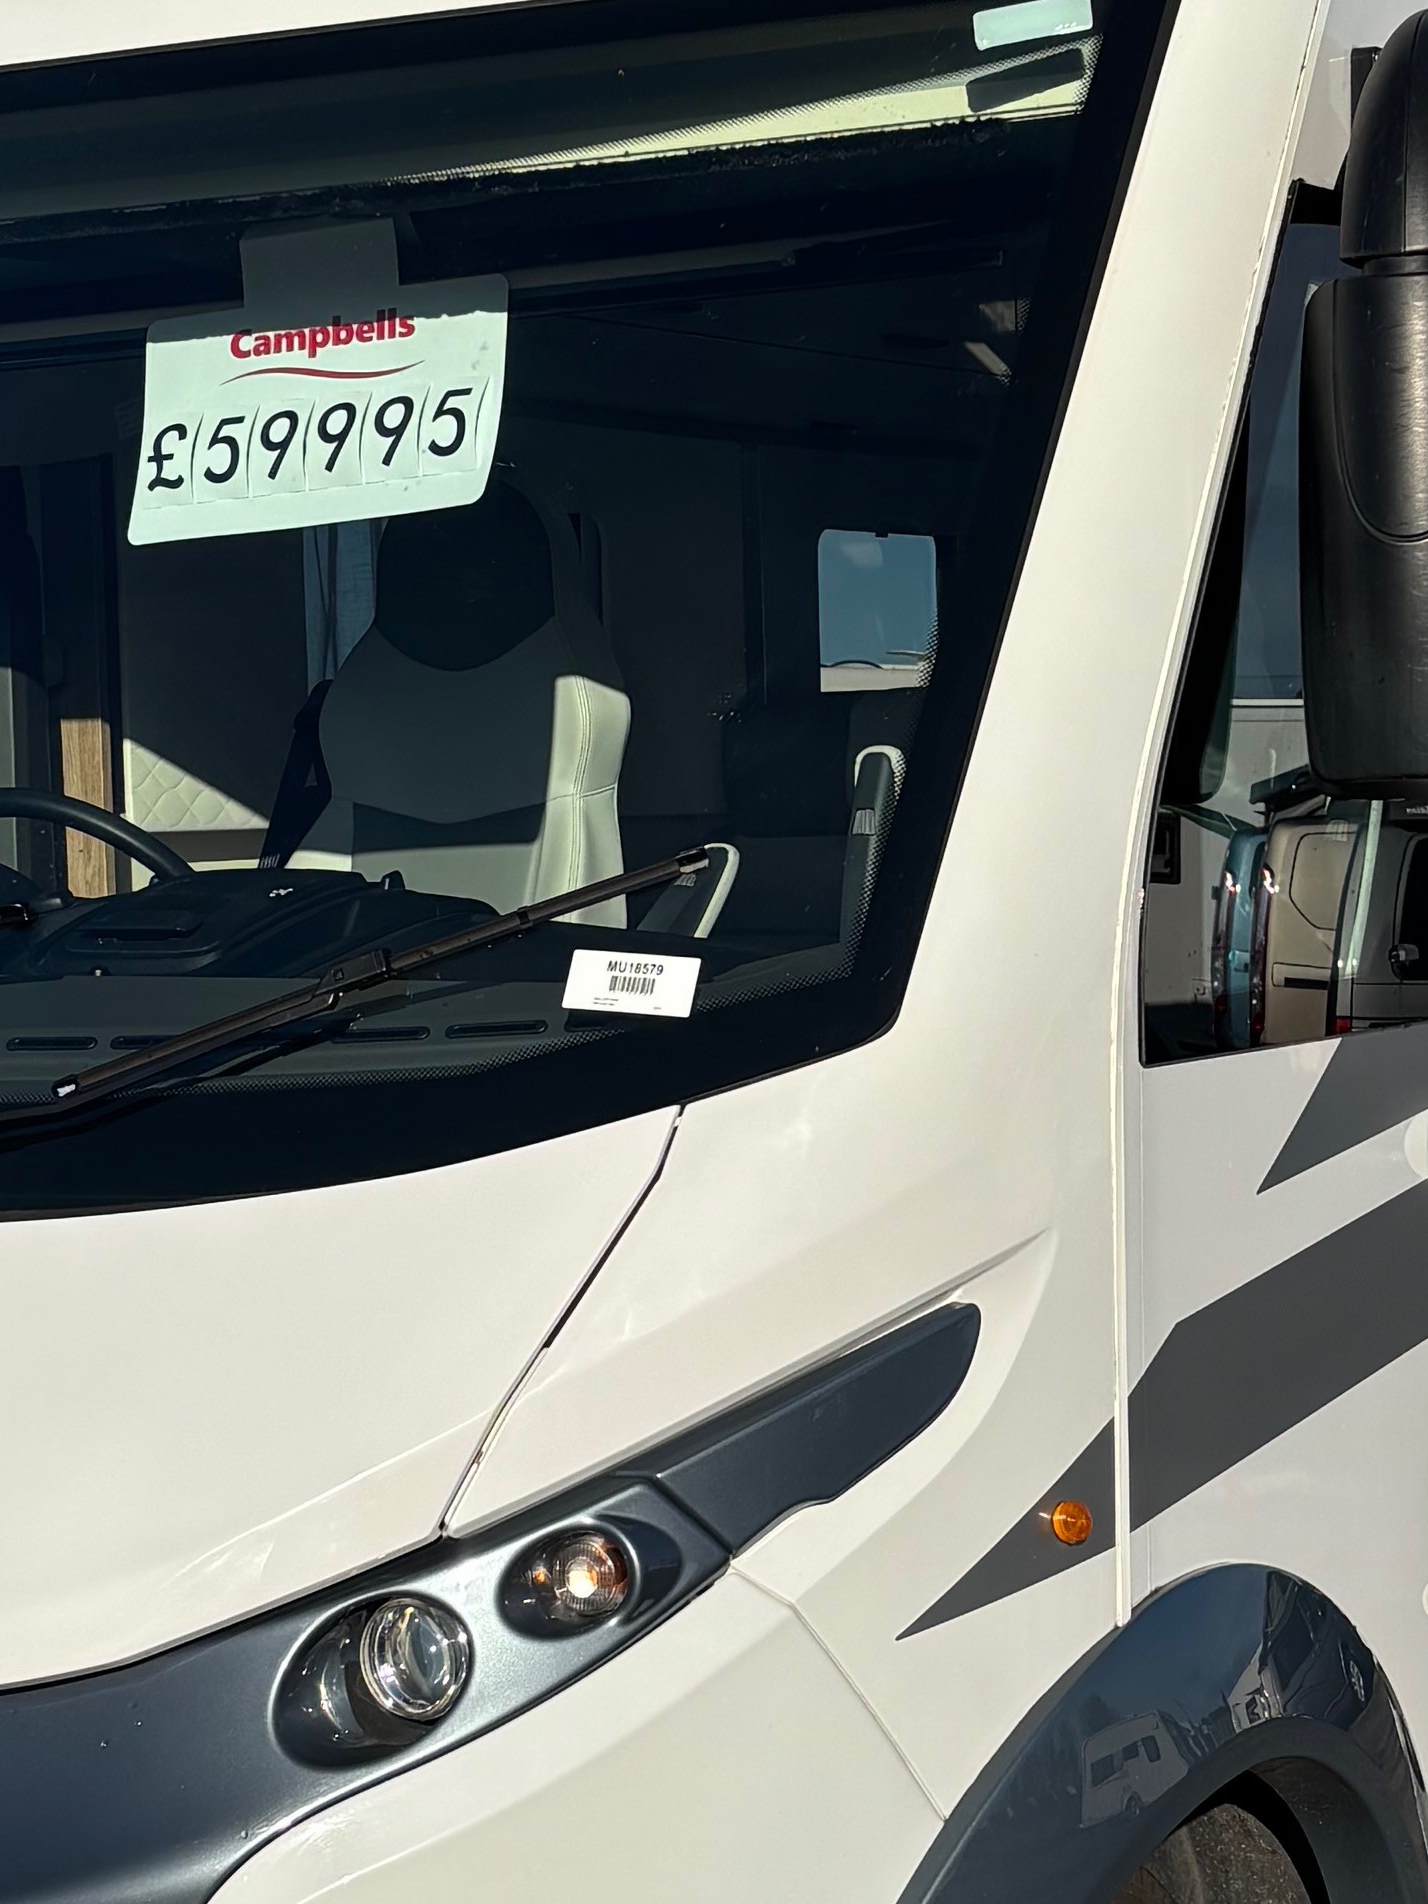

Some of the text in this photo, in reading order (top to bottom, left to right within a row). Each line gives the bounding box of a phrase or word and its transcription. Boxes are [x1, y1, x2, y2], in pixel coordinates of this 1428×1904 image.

[229, 307, 416, 359] Campbells
[147, 387, 474, 492] £59995
[607, 959, 665, 976] MU18579
